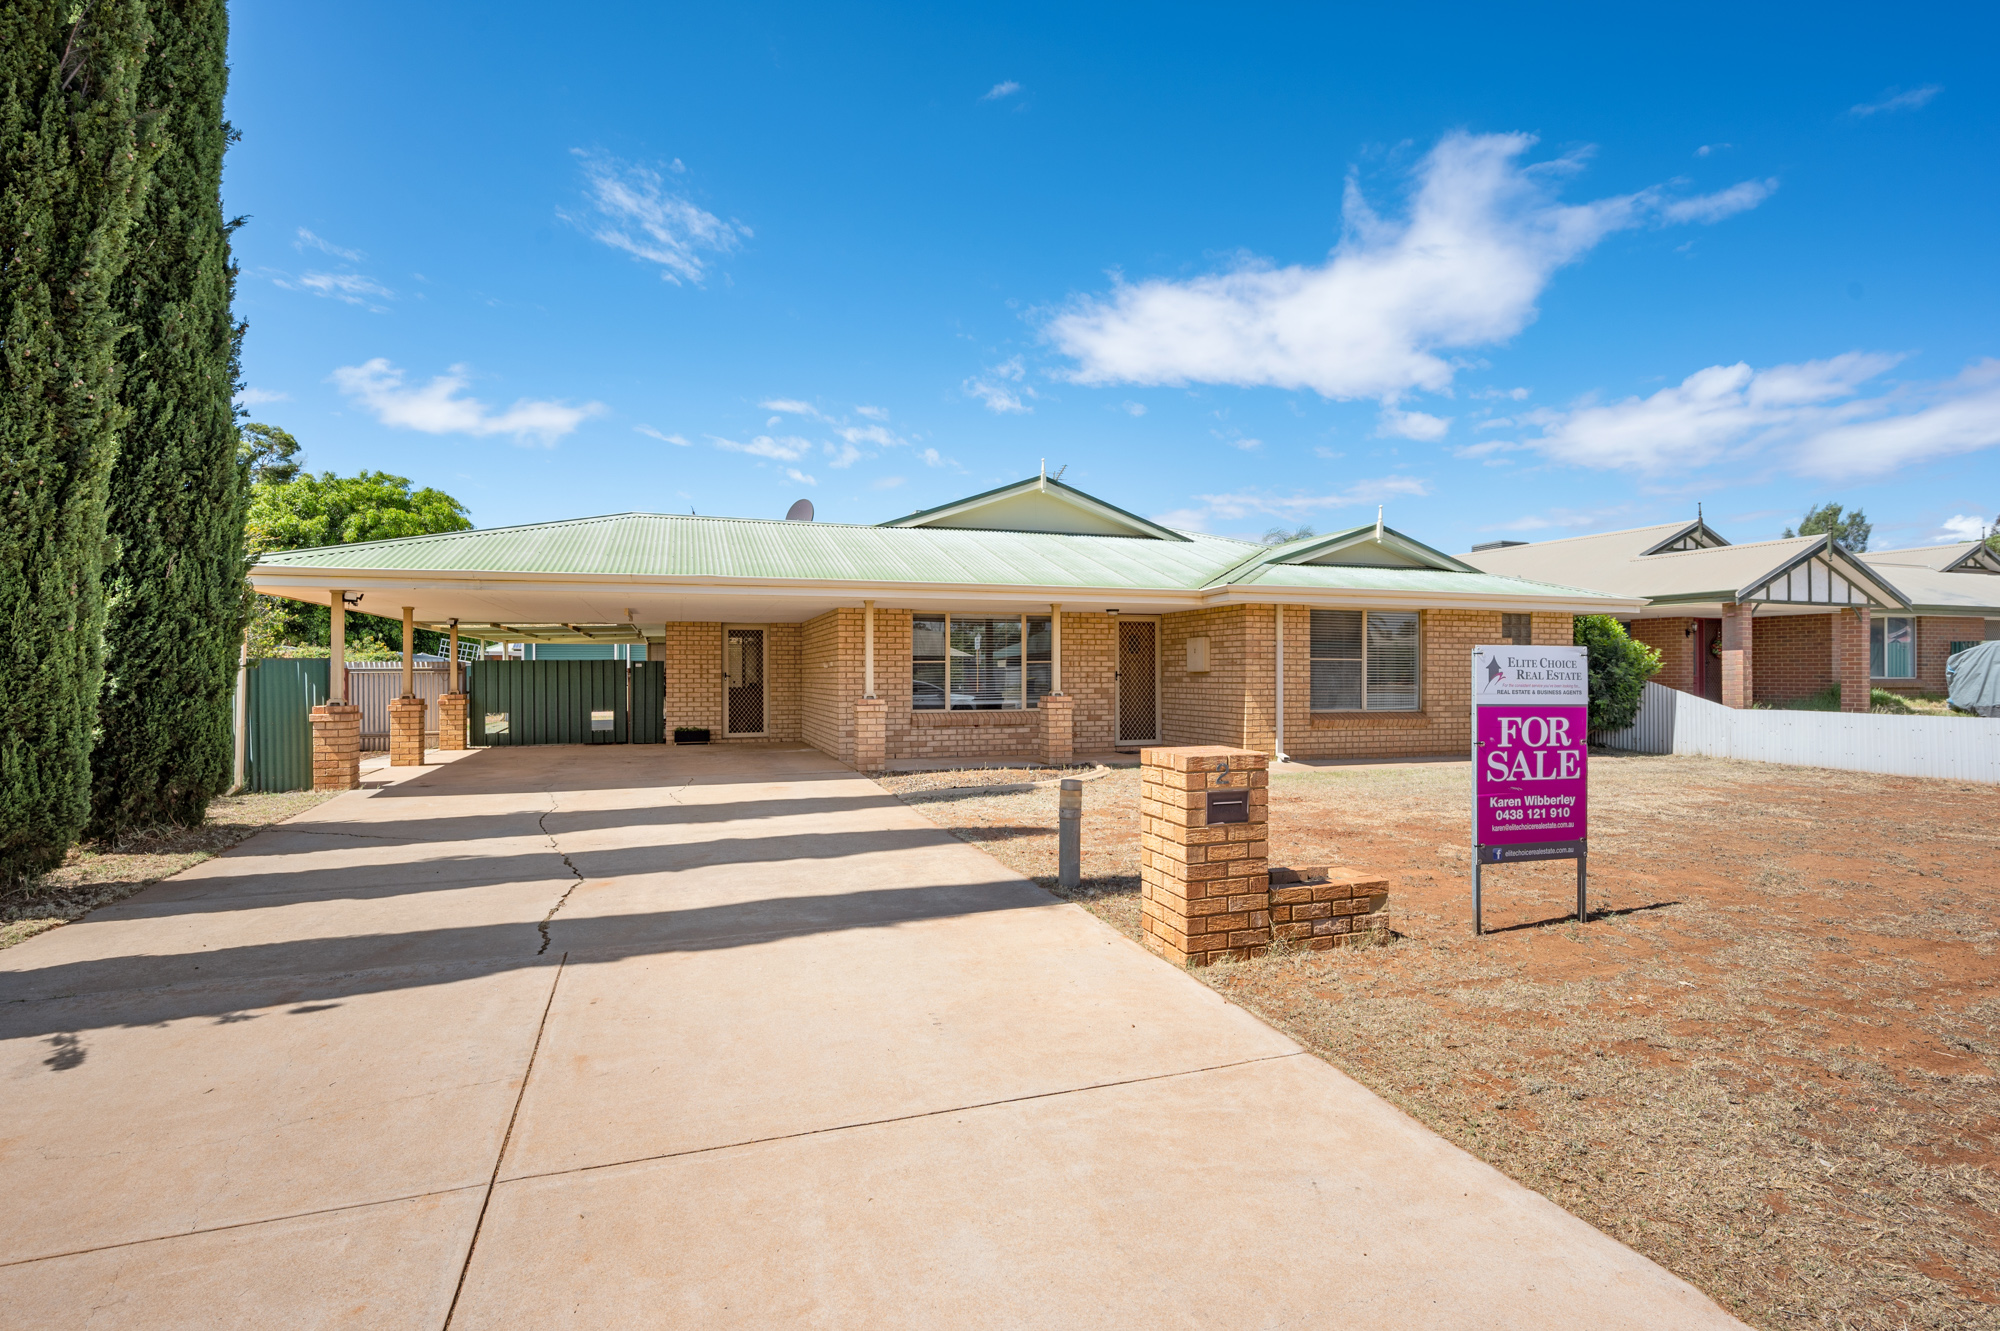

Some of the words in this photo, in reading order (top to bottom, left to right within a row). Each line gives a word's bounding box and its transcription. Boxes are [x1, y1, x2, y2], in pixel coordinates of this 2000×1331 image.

[1507, 656, 1538, 668] ELITE
[1539, 657, 1578, 669] CHOICE
[1516, 669, 1545, 680] REAL
[1546, 669, 1582, 681] ESTATE
[1497, 716, 1572, 748] FOR
[1486, 750, 1581, 782] SALE
[1215, 762, 1230, 785] 2
[1489, 796, 1521, 808] Karen
[1524, 794, 1576, 807] Wibberley
[1495, 809, 1524, 821] 0438
[1527, 808, 1546, 819] 121
[1550, 807, 1570, 818] 910
[1492, 822, 1575, 832] karen@elitechoicerealestate.com.au
[1504, 847, 1575, 857] elitechoicerealestate.com.au
